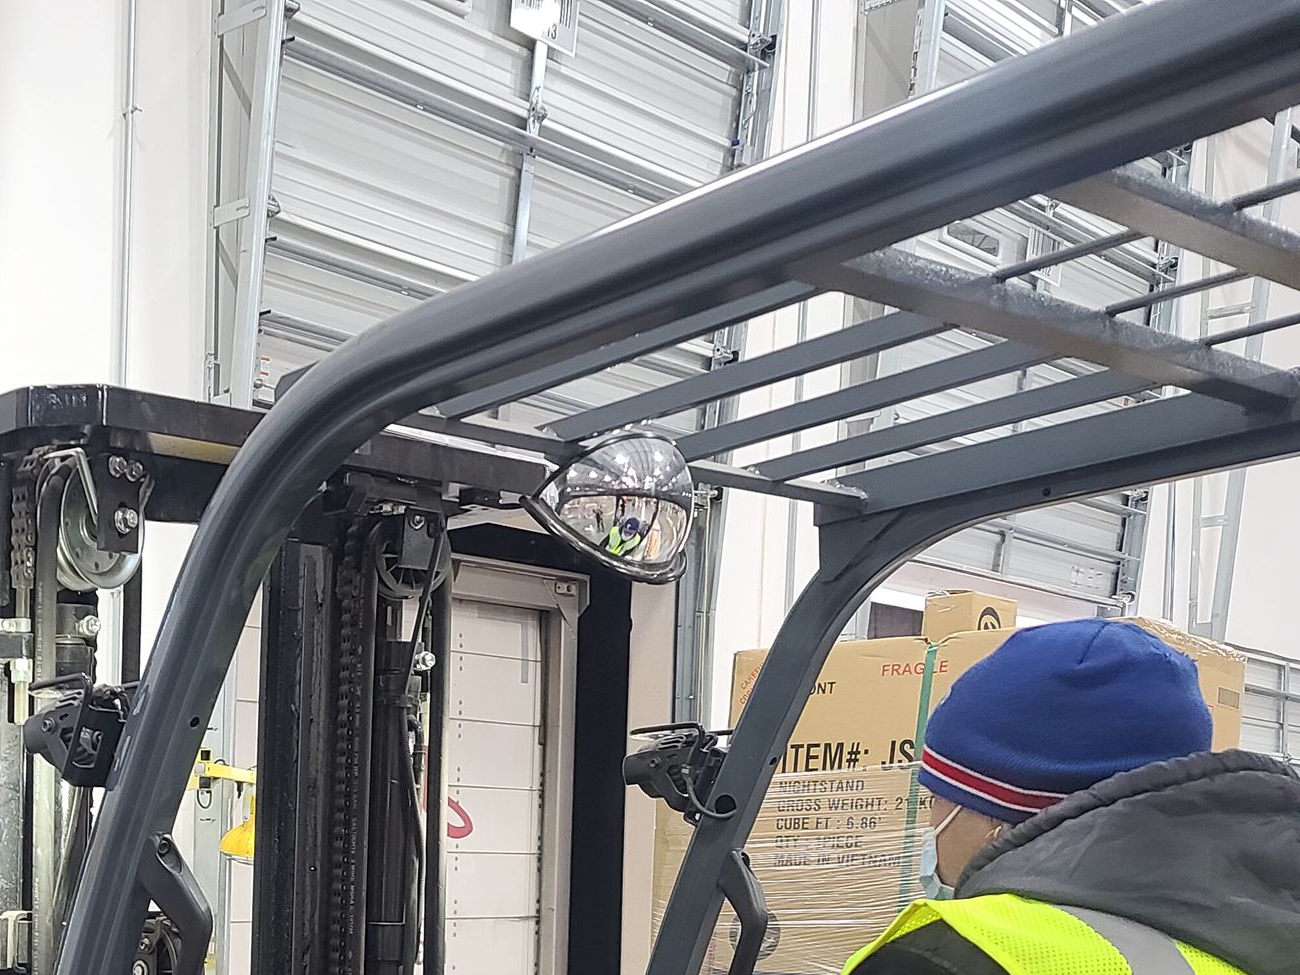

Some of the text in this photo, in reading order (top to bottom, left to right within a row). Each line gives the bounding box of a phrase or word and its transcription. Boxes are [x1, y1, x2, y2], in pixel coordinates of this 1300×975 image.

[779, 779, 865, 793] NIGHTSTAND
[777, 798, 821, 812] GROSS
[828, 797, 888, 811] WEIGHT:
[776, 816, 809, 830] CUBE
[815, 817, 831, 830] FT
